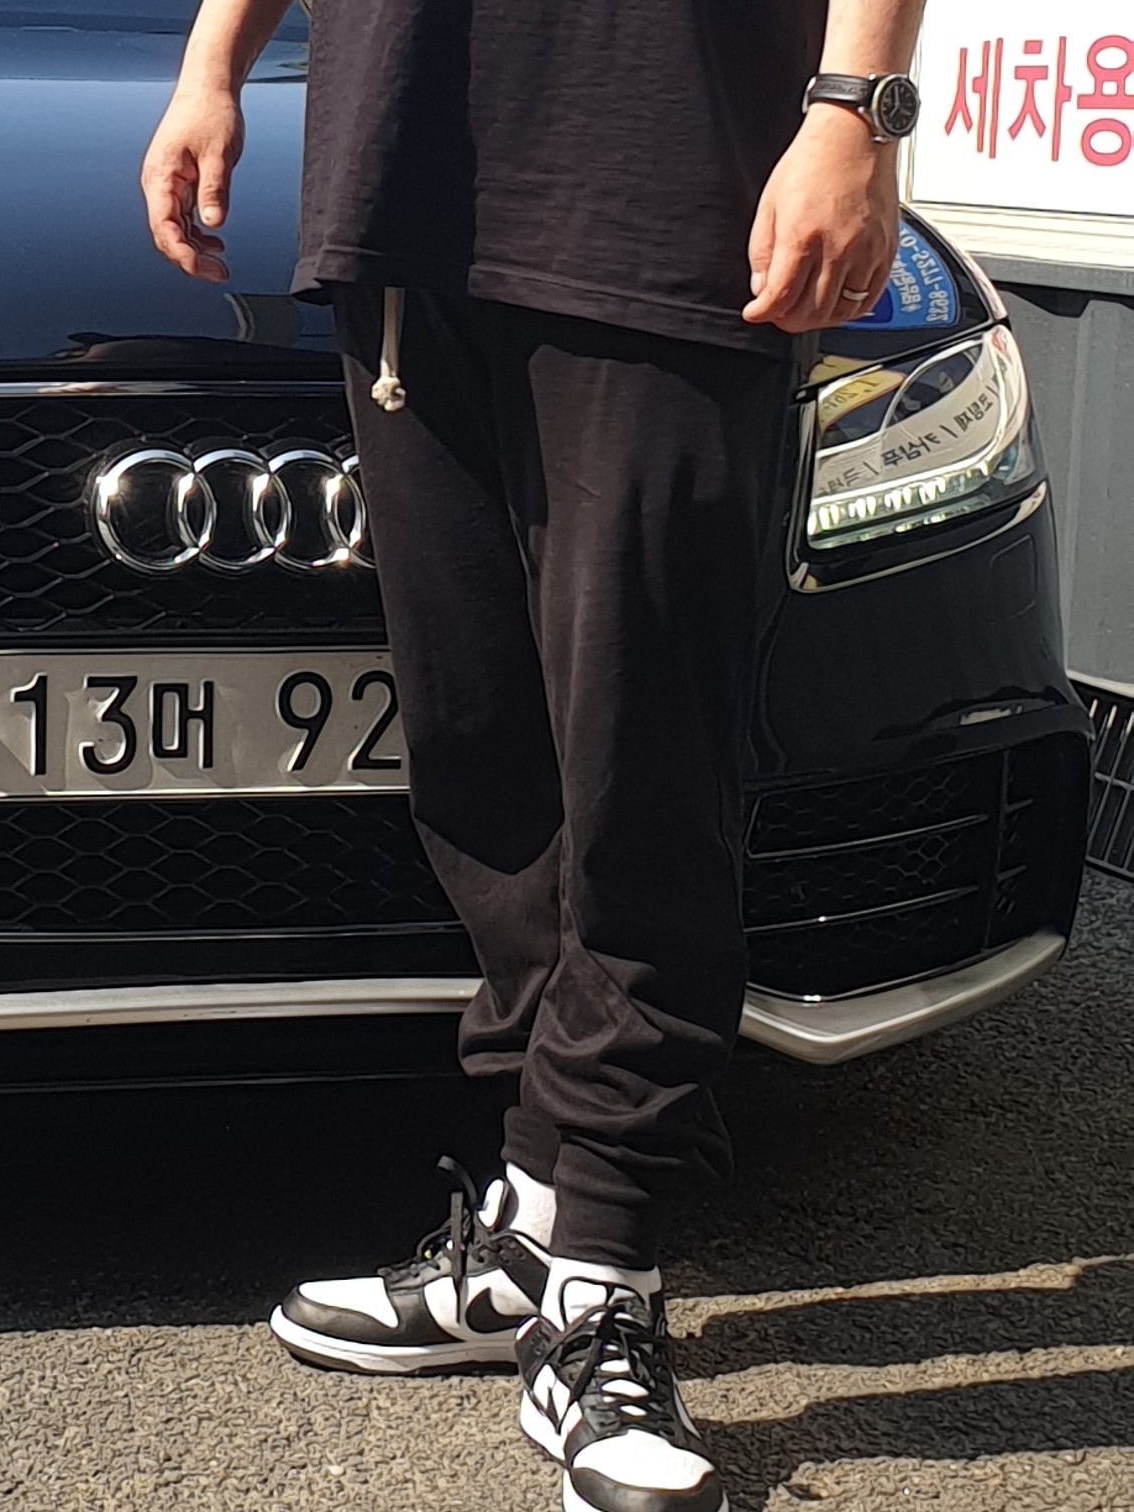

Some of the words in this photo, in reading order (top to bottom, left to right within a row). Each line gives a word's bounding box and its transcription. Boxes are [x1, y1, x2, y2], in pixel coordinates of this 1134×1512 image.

[944, 34, 1134, 167] 세차용
[9, 672, 215, 776] 13머
[276, 669, 403, 774] 92
